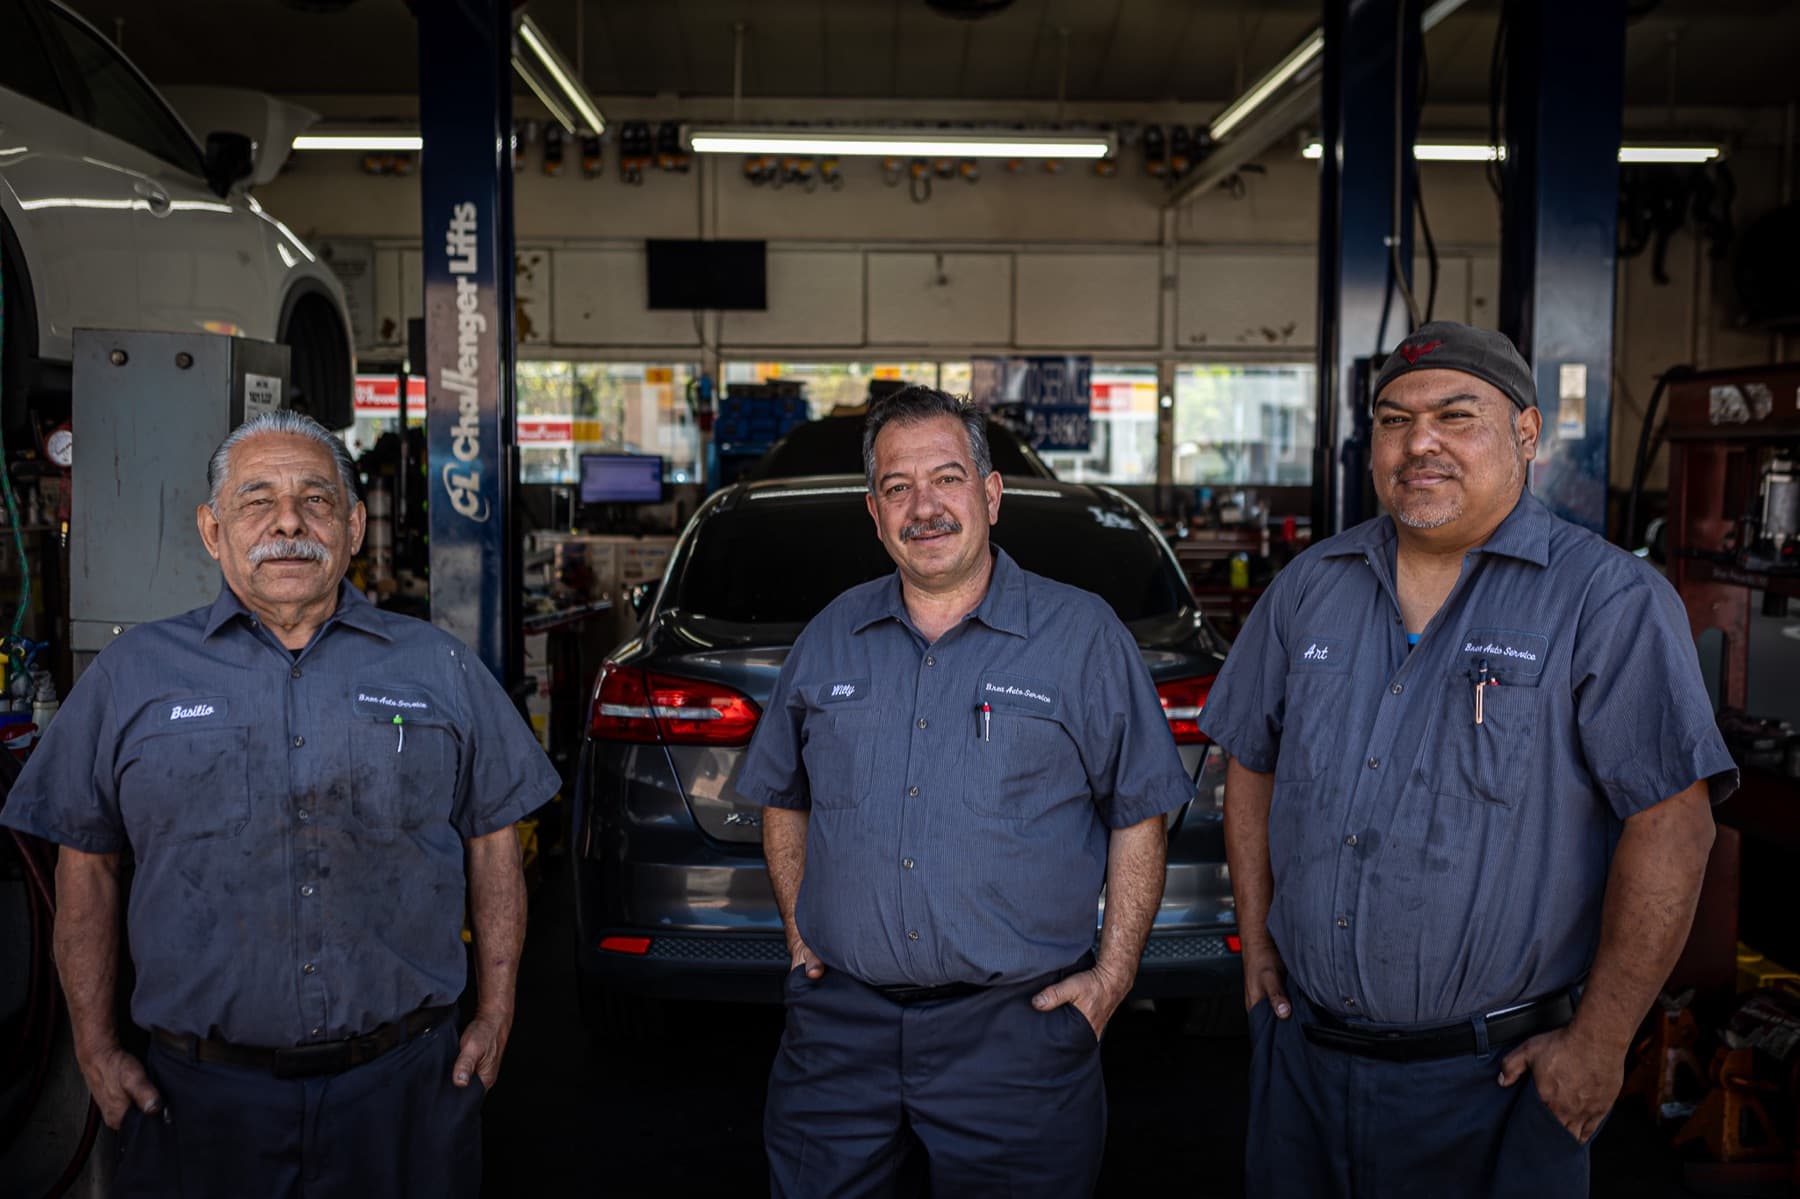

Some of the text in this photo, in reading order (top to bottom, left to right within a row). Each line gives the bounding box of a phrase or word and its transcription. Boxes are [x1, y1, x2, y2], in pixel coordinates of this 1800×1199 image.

[446, 201, 477, 273] Lifts
[441, 276, 486, 461] Challenger
[1304, 643, 1328, 660] Art
[1482, 643, 1503, 655] Auto
[1503, 646, 1536, 660] Service
[1006, 686, 1024, 696] Auto
[1023, 689, 1051, 703] Service
[170, 704, 214, 720] Basilio
